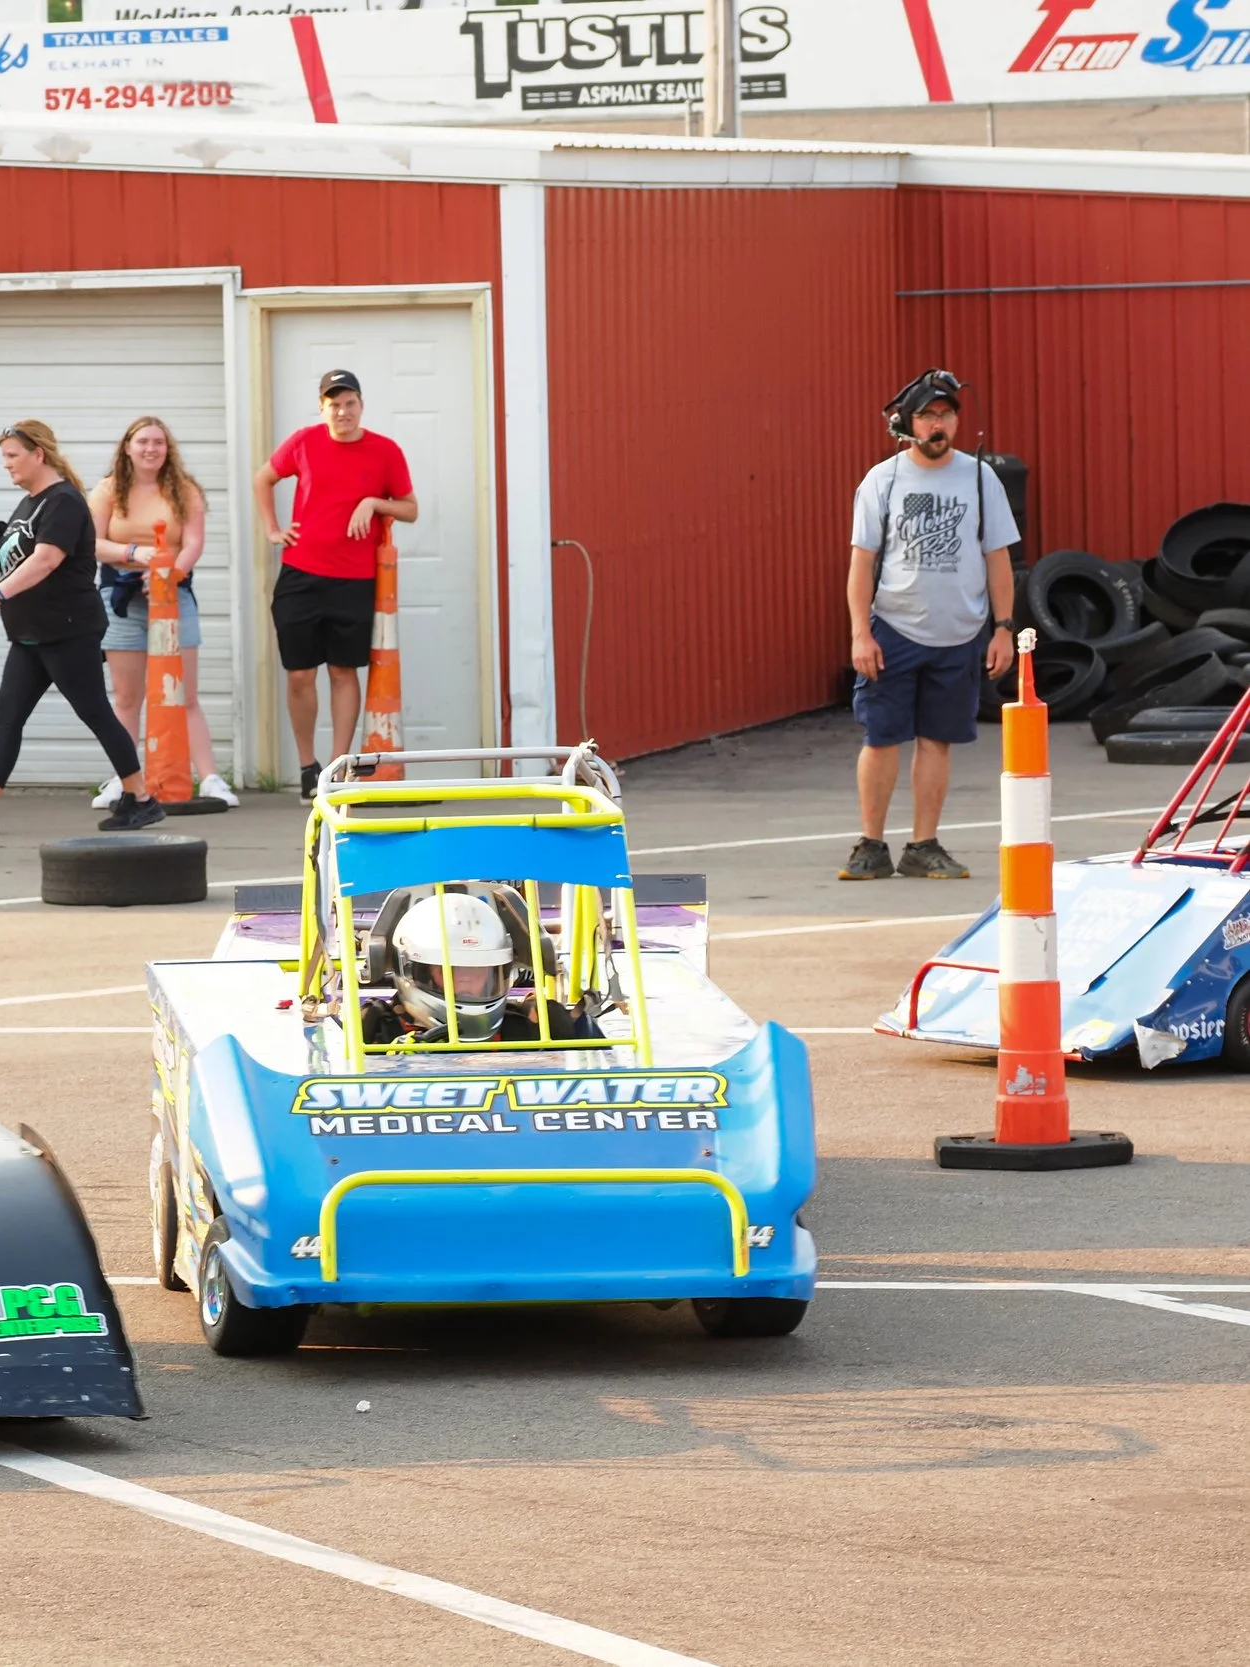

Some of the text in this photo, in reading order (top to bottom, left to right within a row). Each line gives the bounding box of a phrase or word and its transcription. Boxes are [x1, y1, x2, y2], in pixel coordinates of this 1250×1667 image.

[52, 28, 220, 47] TRAILER SALES
[47, 57, 164, 71] ELKHART IN
[460, 7, 791, 98] TUSTIS
[44, 82, 233, 111] 574-294-7200
[577, 84, 653, 105] ASPHALT
[302, 1075, 718, 1109] SWEET WATER
[310, 1109, 718, 1136] MEDICAL CENTER
